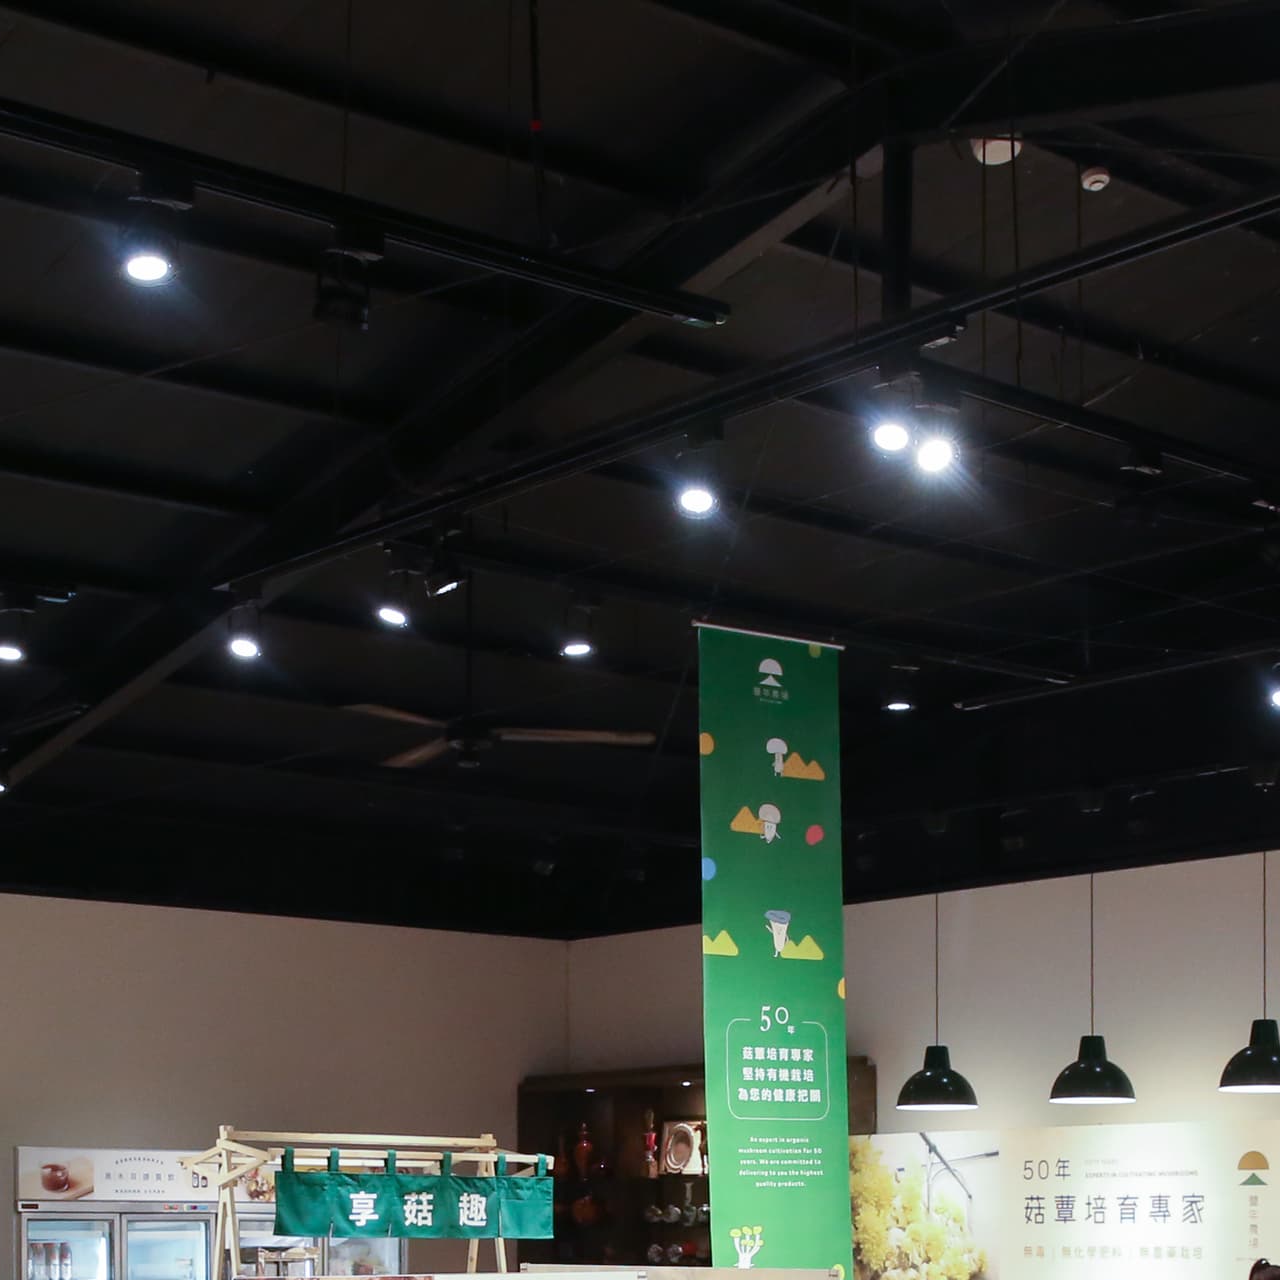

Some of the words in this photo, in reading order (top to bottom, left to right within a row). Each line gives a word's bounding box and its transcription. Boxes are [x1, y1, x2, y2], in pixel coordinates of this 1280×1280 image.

[742, 1046, 814, 1062] 菇蕈培育專家
[742, 1067, 814, 1082] 堅持有機栽培
[737, 1087, 821, 1103] 為您的健康把關
[1023, 1158, 1071, 1181] 50年
[348, 1190, 488, 1227] 享菇趣
[1024, 1193, 1205, 1225] 菇蕈培育專家
